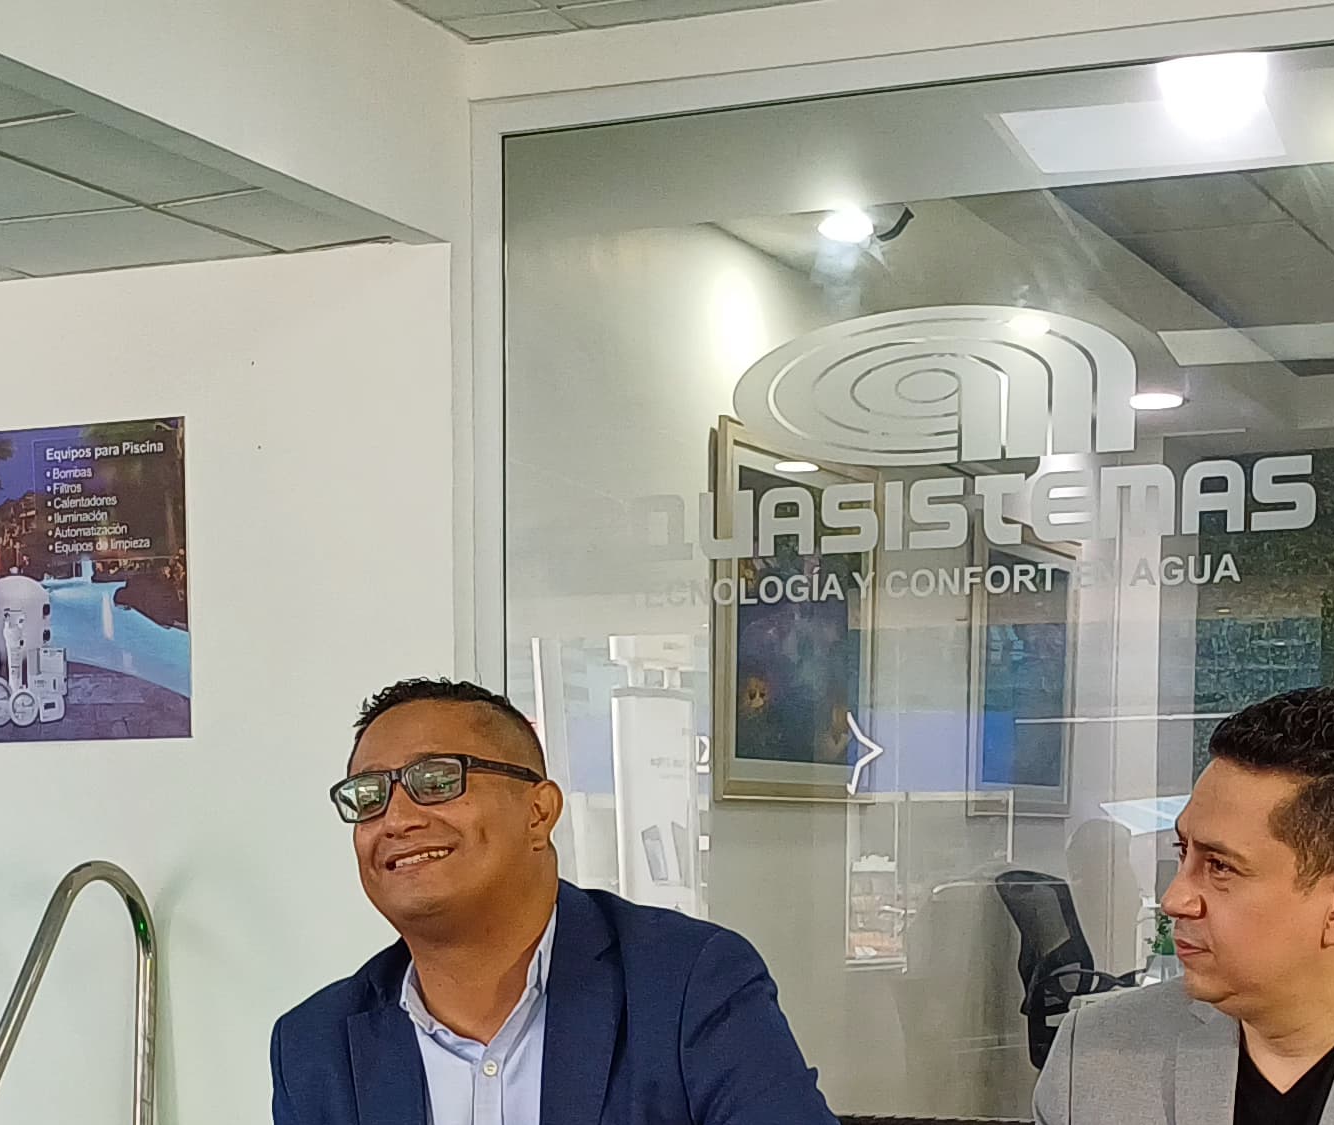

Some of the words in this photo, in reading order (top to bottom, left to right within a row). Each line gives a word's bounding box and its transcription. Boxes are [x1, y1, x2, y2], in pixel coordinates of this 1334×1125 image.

[46, 447, 91, 463] Equipos
[94, 445, 119, 460] para
[122, 440, 164, 455] Piscina
[52, 467, 92, 480] Bombas
[53, 482, 82, 495] Filtros
[53, 495, 118, 509] Calentadores
[644, 455, 1317, 560] QUASISTEMAS
[54, 523, 128, 538] Automatización
[55, 541, 93, 555] Equipos
[110, 537, 151, 552] limpieza
[635, 566, 845, 607] ECNOLOGÍA
[851, 571, 876, 600] Y
[885, 563, 1061, 599] CONFORT
[1129, 553, 1242, 588] AGUA
